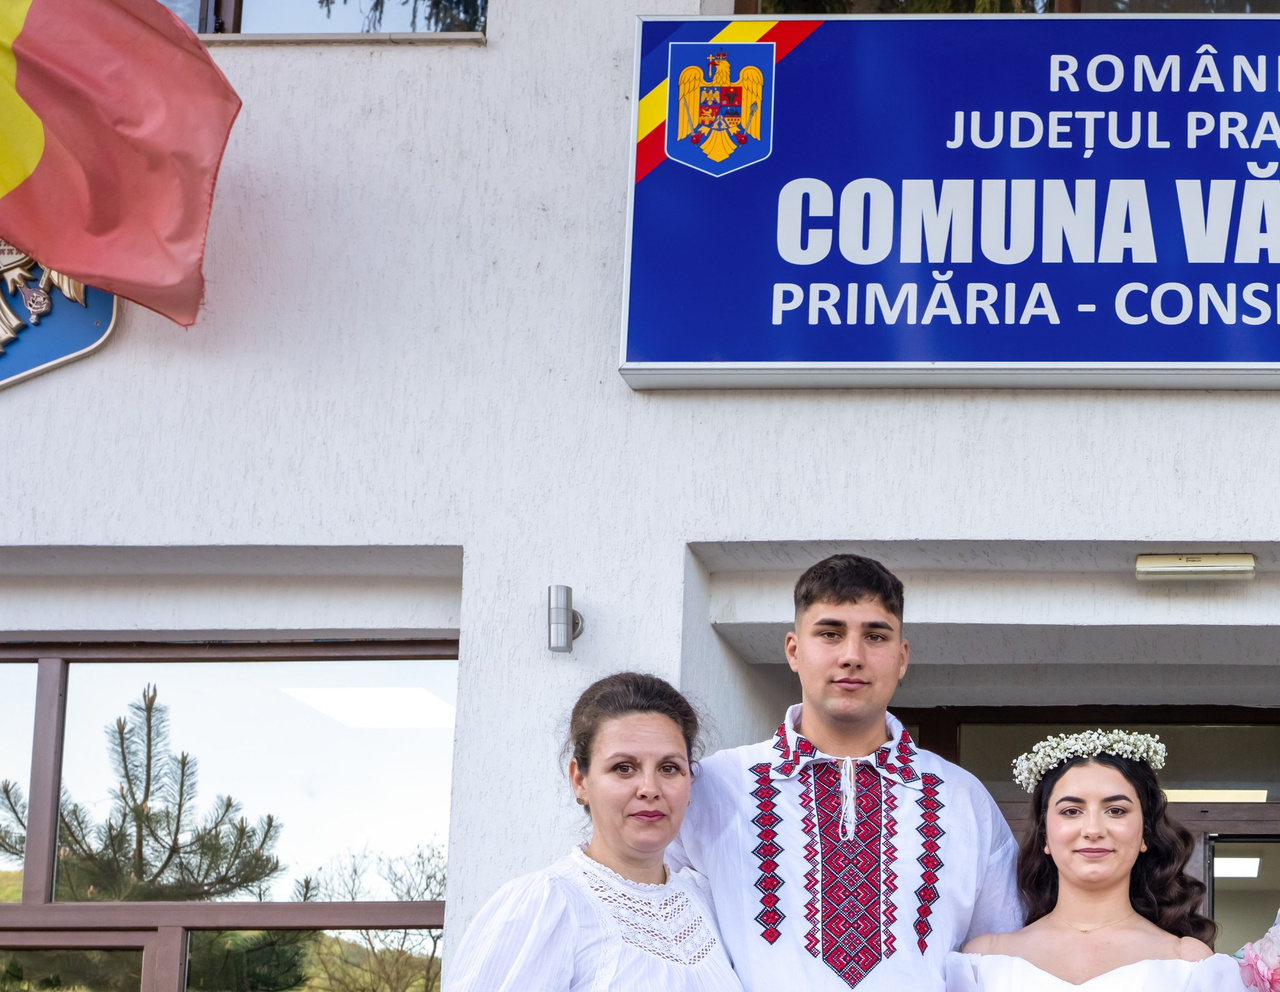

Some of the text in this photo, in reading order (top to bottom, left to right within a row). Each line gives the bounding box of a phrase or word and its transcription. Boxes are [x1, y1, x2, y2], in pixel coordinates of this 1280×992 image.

[946, 111, 1171, 159] JUDEȚUL
[776, 177, 1158, 266] COMUNA
[772, 270, 1061, 325] PRIMĂRIA
